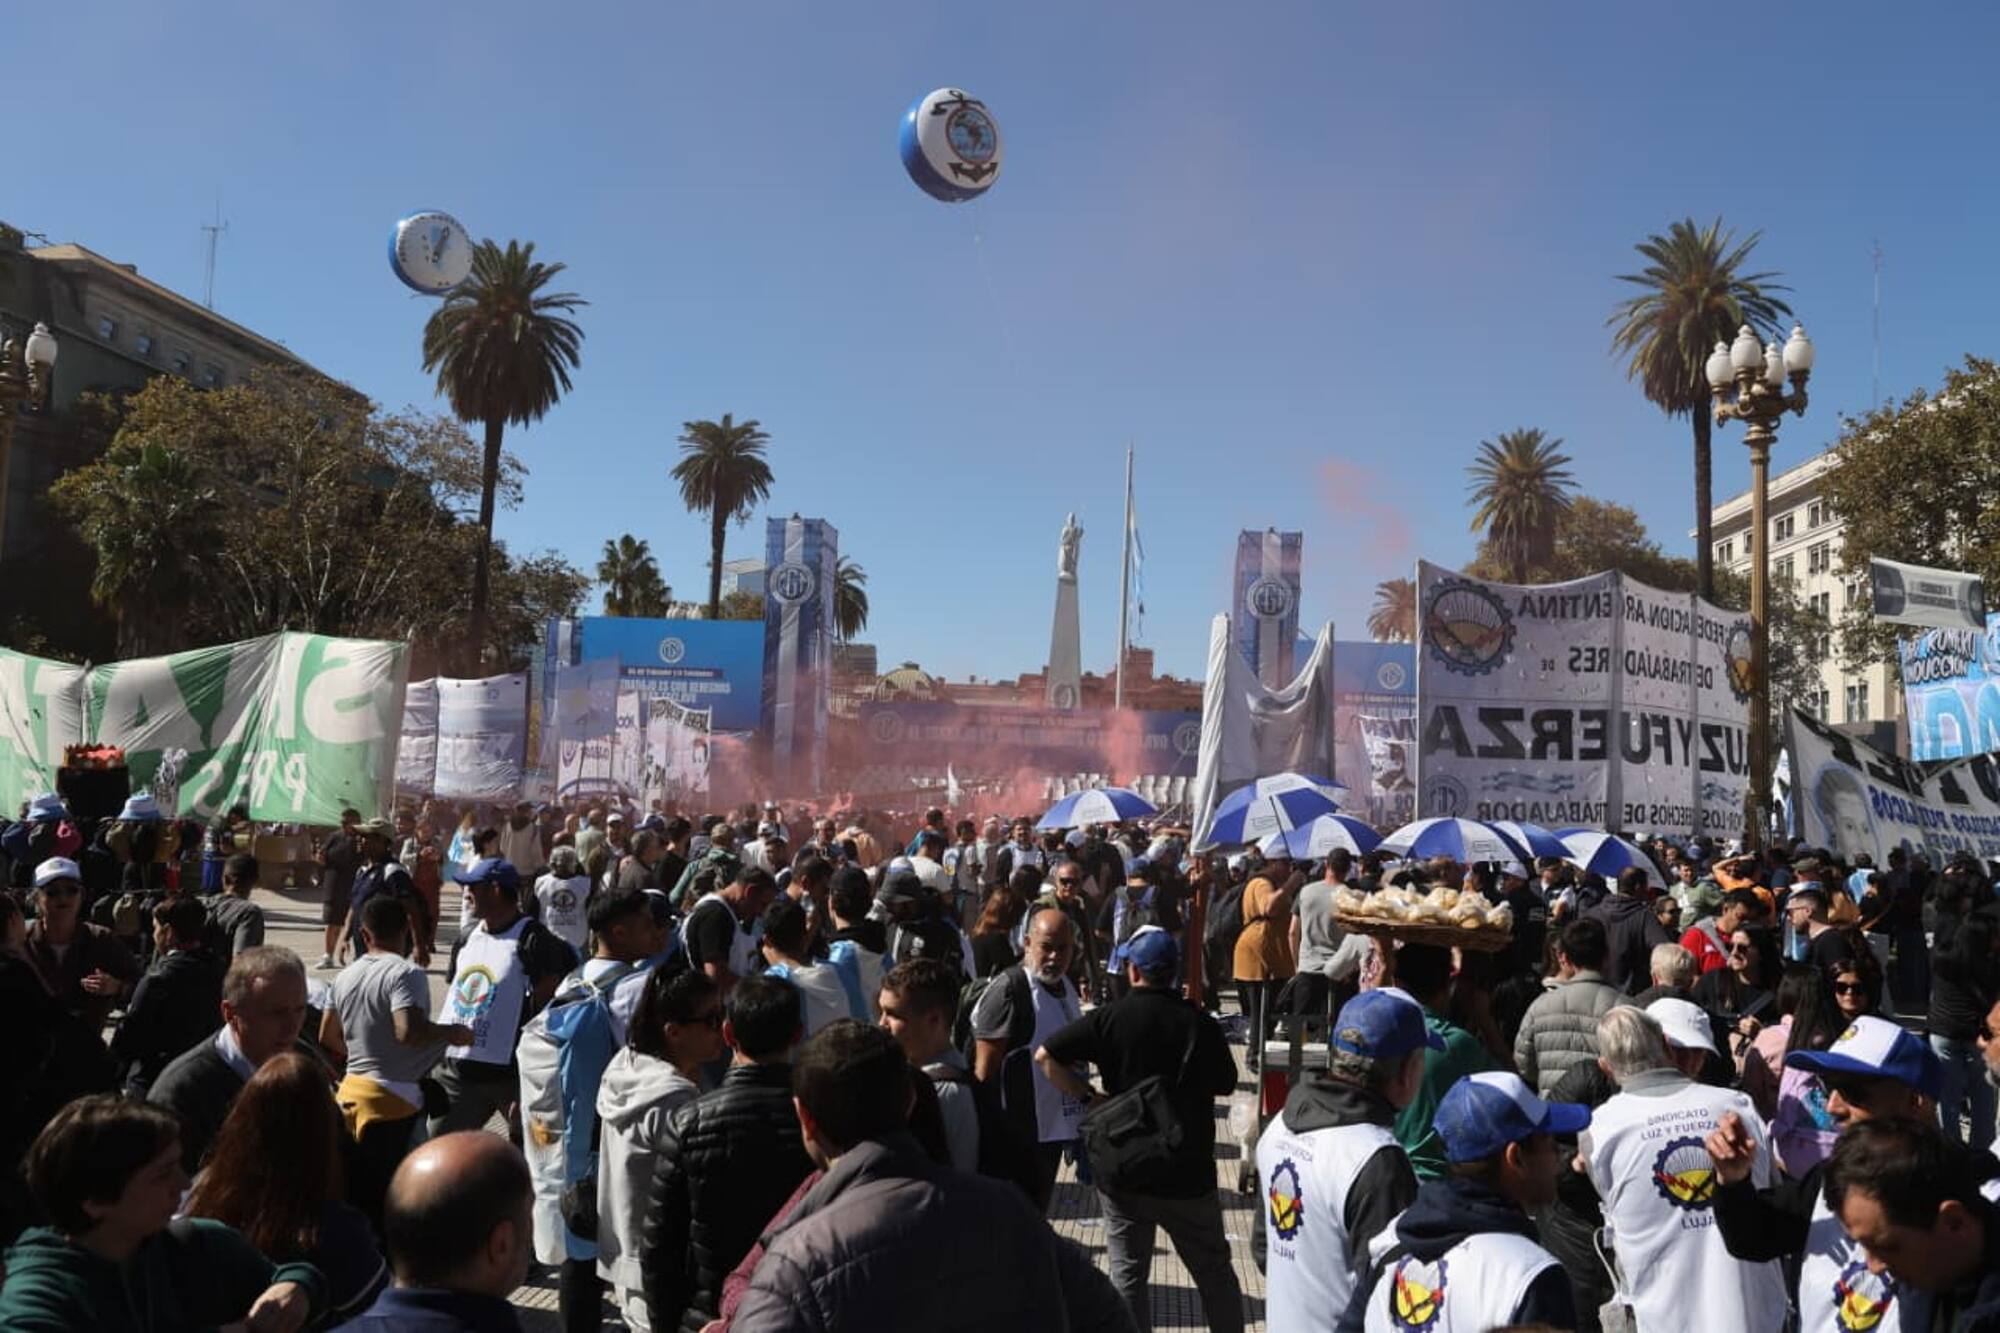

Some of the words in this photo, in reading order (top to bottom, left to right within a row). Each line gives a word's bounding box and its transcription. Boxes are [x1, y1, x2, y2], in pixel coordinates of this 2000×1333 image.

[1641, 1128, 1663, 1140] LUZ
[1666, 1126, 1673, 1135] Y
[1675, 1120, 1720, 1133] FUERZA
